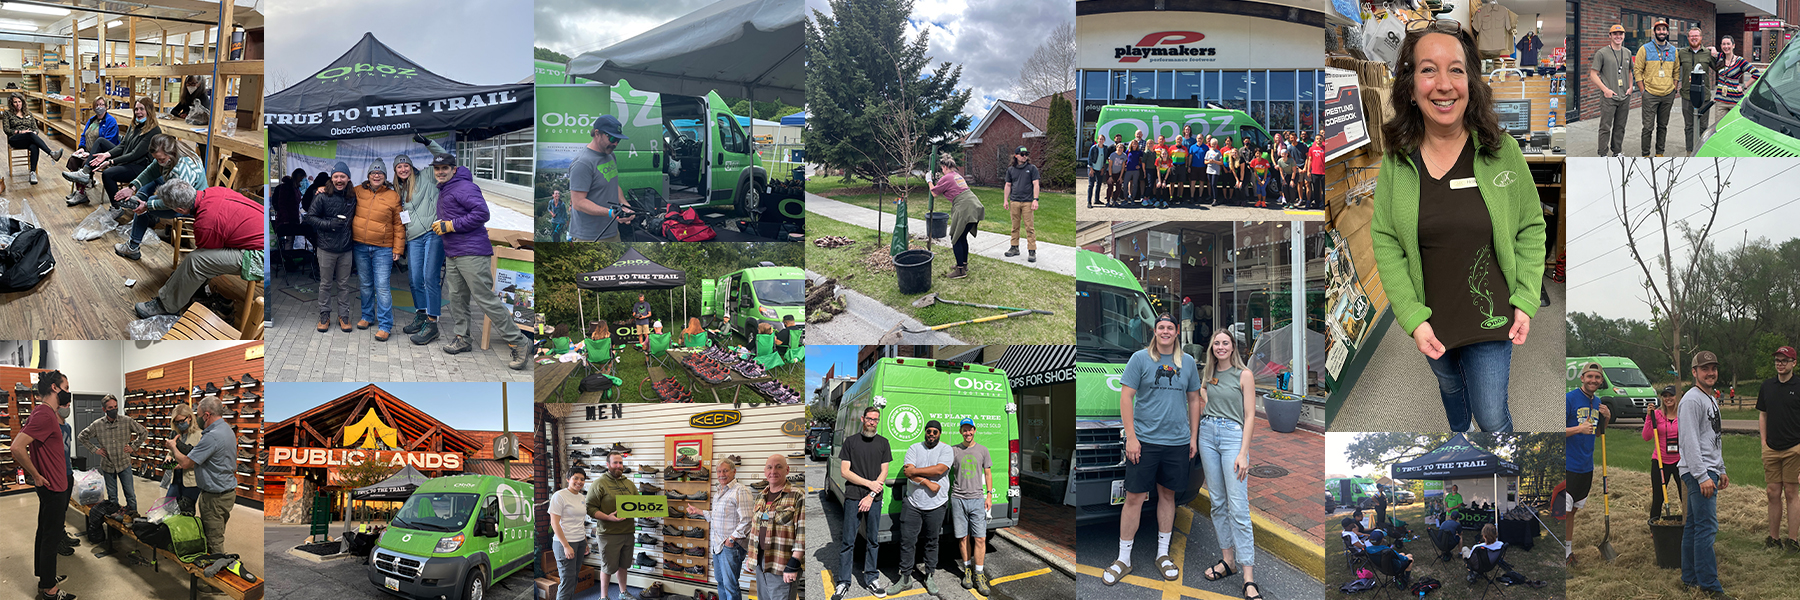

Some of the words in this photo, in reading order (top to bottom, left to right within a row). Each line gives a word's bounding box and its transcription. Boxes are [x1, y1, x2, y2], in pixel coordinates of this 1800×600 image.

[1114, 45, 1216, 58] playmakers
[264, 112, 323, 125] TRUE
[328, 108, 360, 122] TO
[366, 102, 421, 118] THE
[428, 91, 517, 113] TRAIL
[591, 274, 616, 282] TRUE
[652, 272, 679, 280] TRAIL
[1026, 373, 1044, 386] FOR
[585, 404, 622, 420] MEN
[692, 413, 738, 425] KEEN
[273, 447, 366, 467] PUBLIC
[374, 450, 460, 469] LANDS
[1402, 465, 1423, 473] TRUE
[1456, 460, 1487, 468] TRAIL
